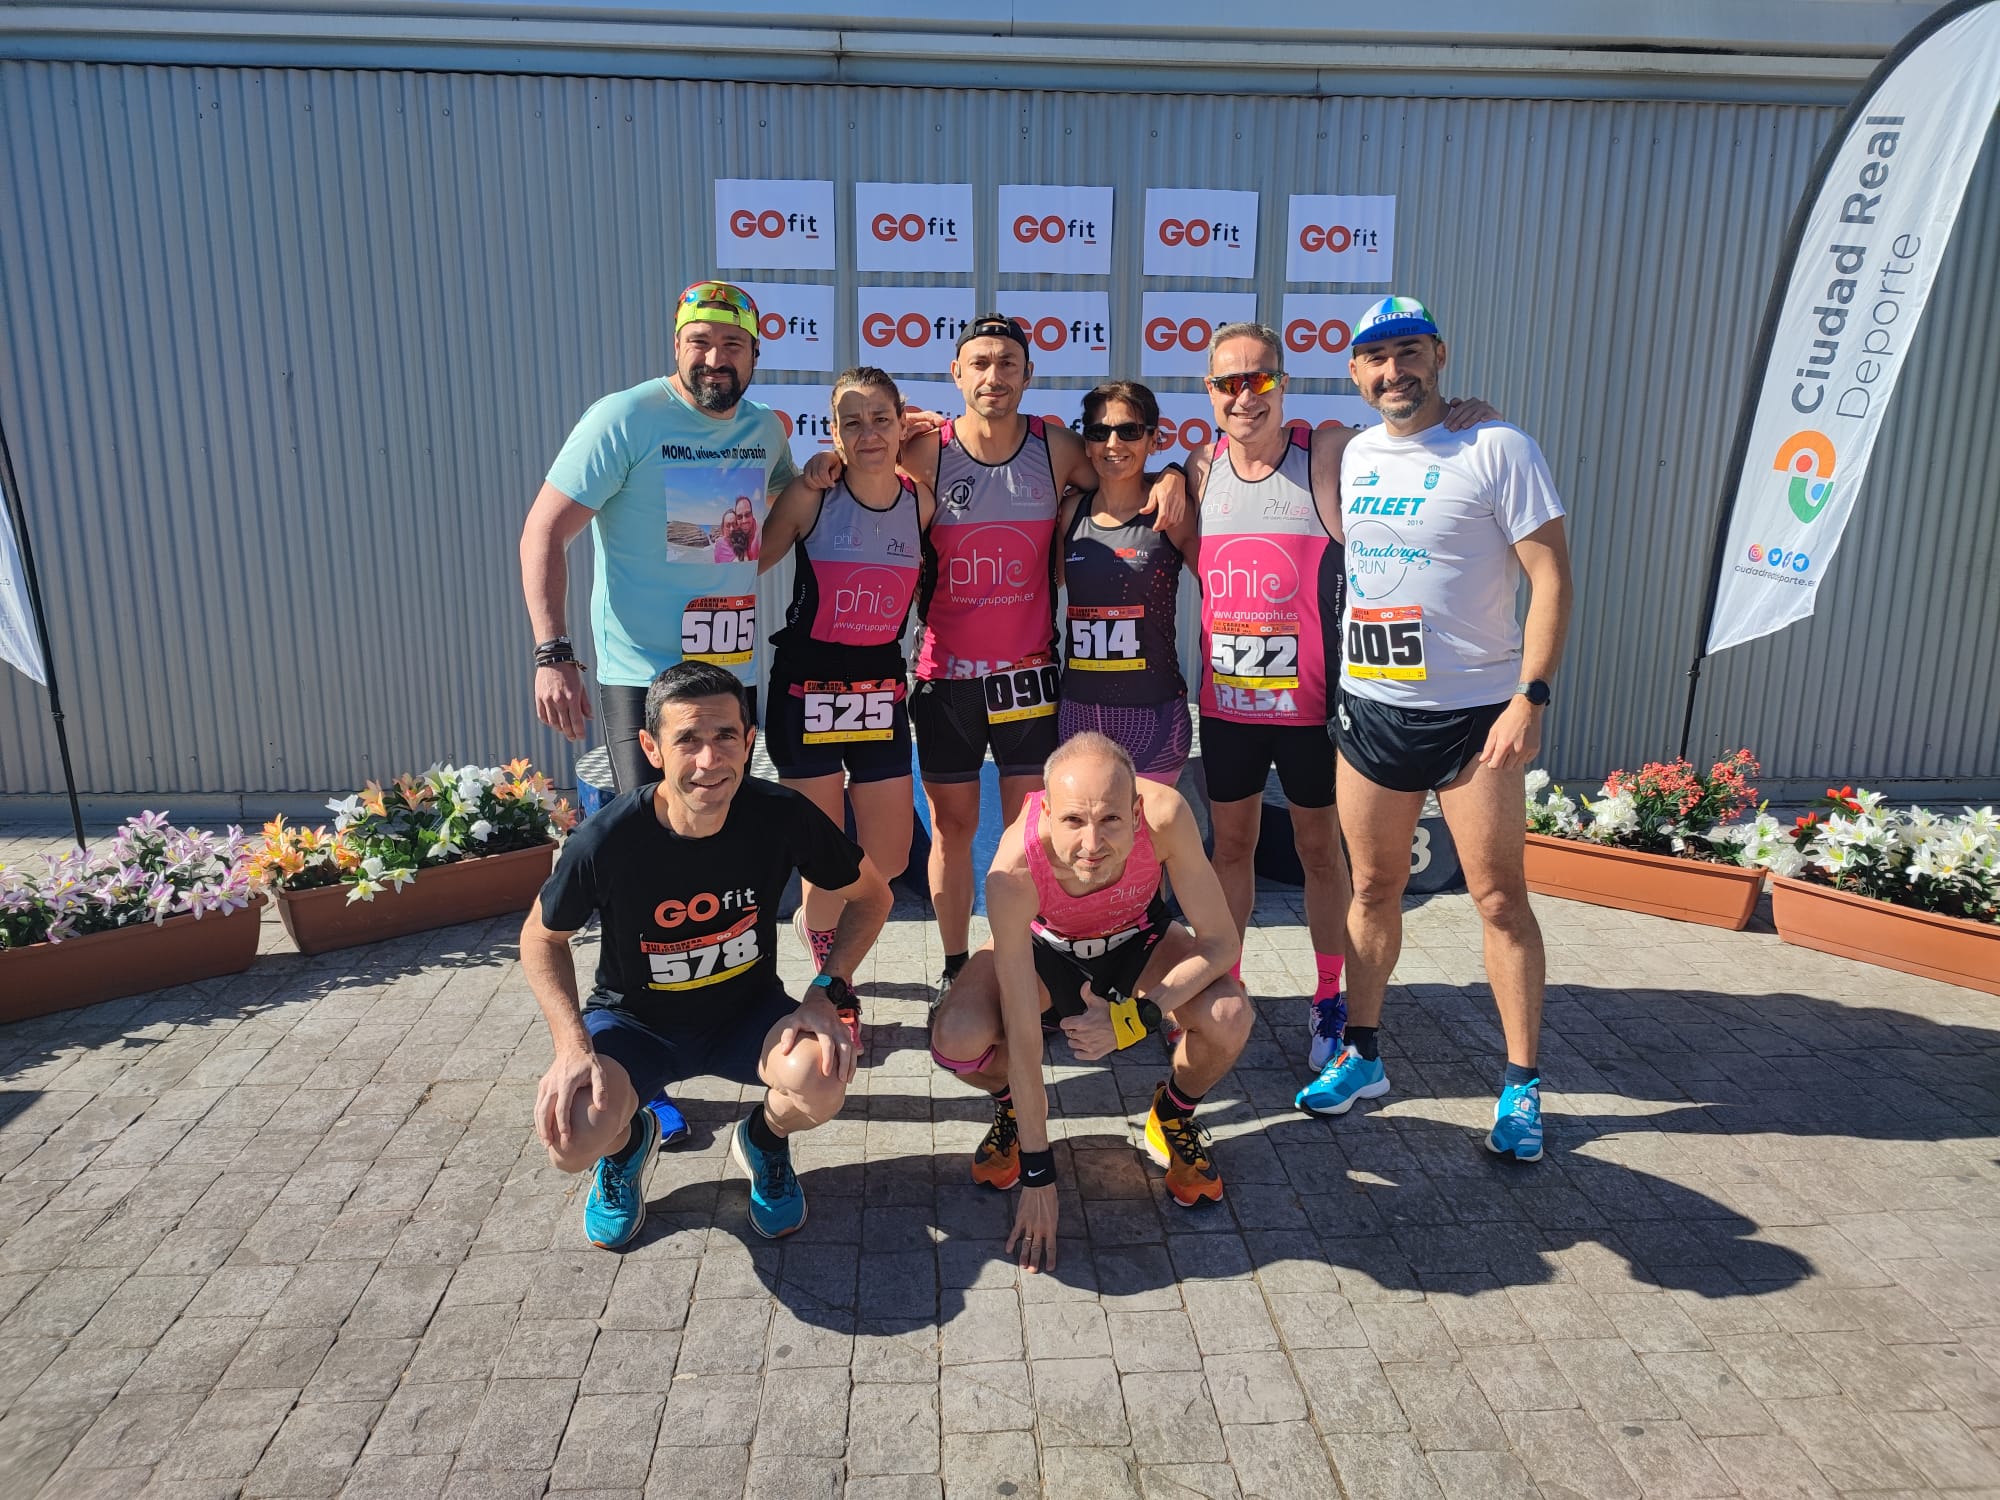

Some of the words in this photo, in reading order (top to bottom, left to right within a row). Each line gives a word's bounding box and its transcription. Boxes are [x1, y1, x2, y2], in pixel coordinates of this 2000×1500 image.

[1791, 243, 1867, 414] Ciudad
[1839, 115, 1906, 225] Real
[759, 312, 819, 341] Ofit
[1836, 233, 1922, 420] Deporte
[661, 444, 696, 461] MOMO,
[695, 444, 721, 459] vives
[1348, 496, 1427, 516] ATLEET
[1406, 519, 1424, 527] 2019
[1350, 539, 1430, 565] Pandorga
[1357, 560, 1386, 576] RUN
[951, 591, 1035, 608] www.grupophi.es
[1211, 609, 1299, 623] www.grupophi.es
[682, 608, 756, 653] 505
[1071, 619, 1140, 660] 514
[1348, 621, 1423, 666] 005
[1210, 634, 1298, 677] 522
[985, 664, 1059, 713] 090
[804, 692, 894, 733] 525
[648, 928, 760, 984] 578
